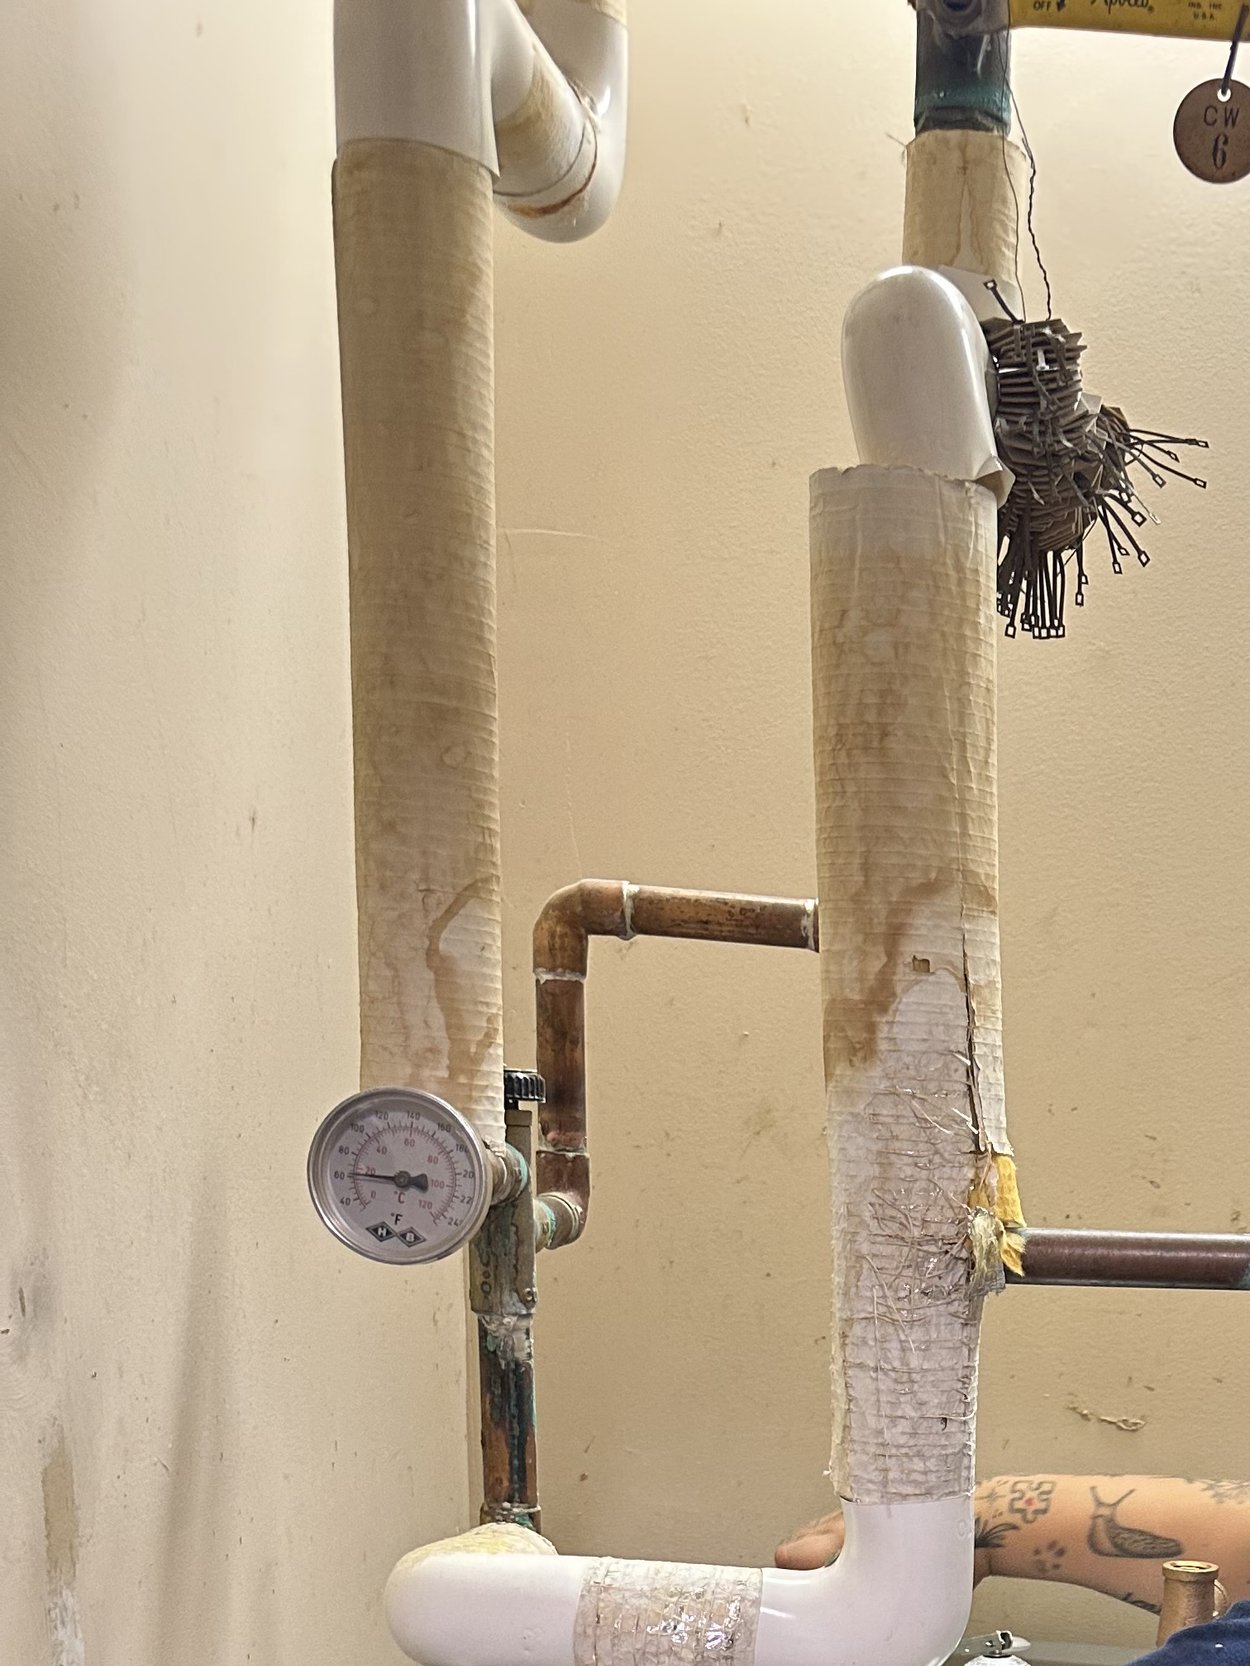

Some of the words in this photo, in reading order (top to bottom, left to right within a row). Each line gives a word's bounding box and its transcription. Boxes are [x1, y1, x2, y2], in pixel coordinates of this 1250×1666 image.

[1212, 133, 1229, 169] 6
[407, 1111, 420, 1120] 140
[431, 1180, 445, 1189] 100
[340, 1197, 351, 1206] 40
[418, 1200, 433, 1209] 120
